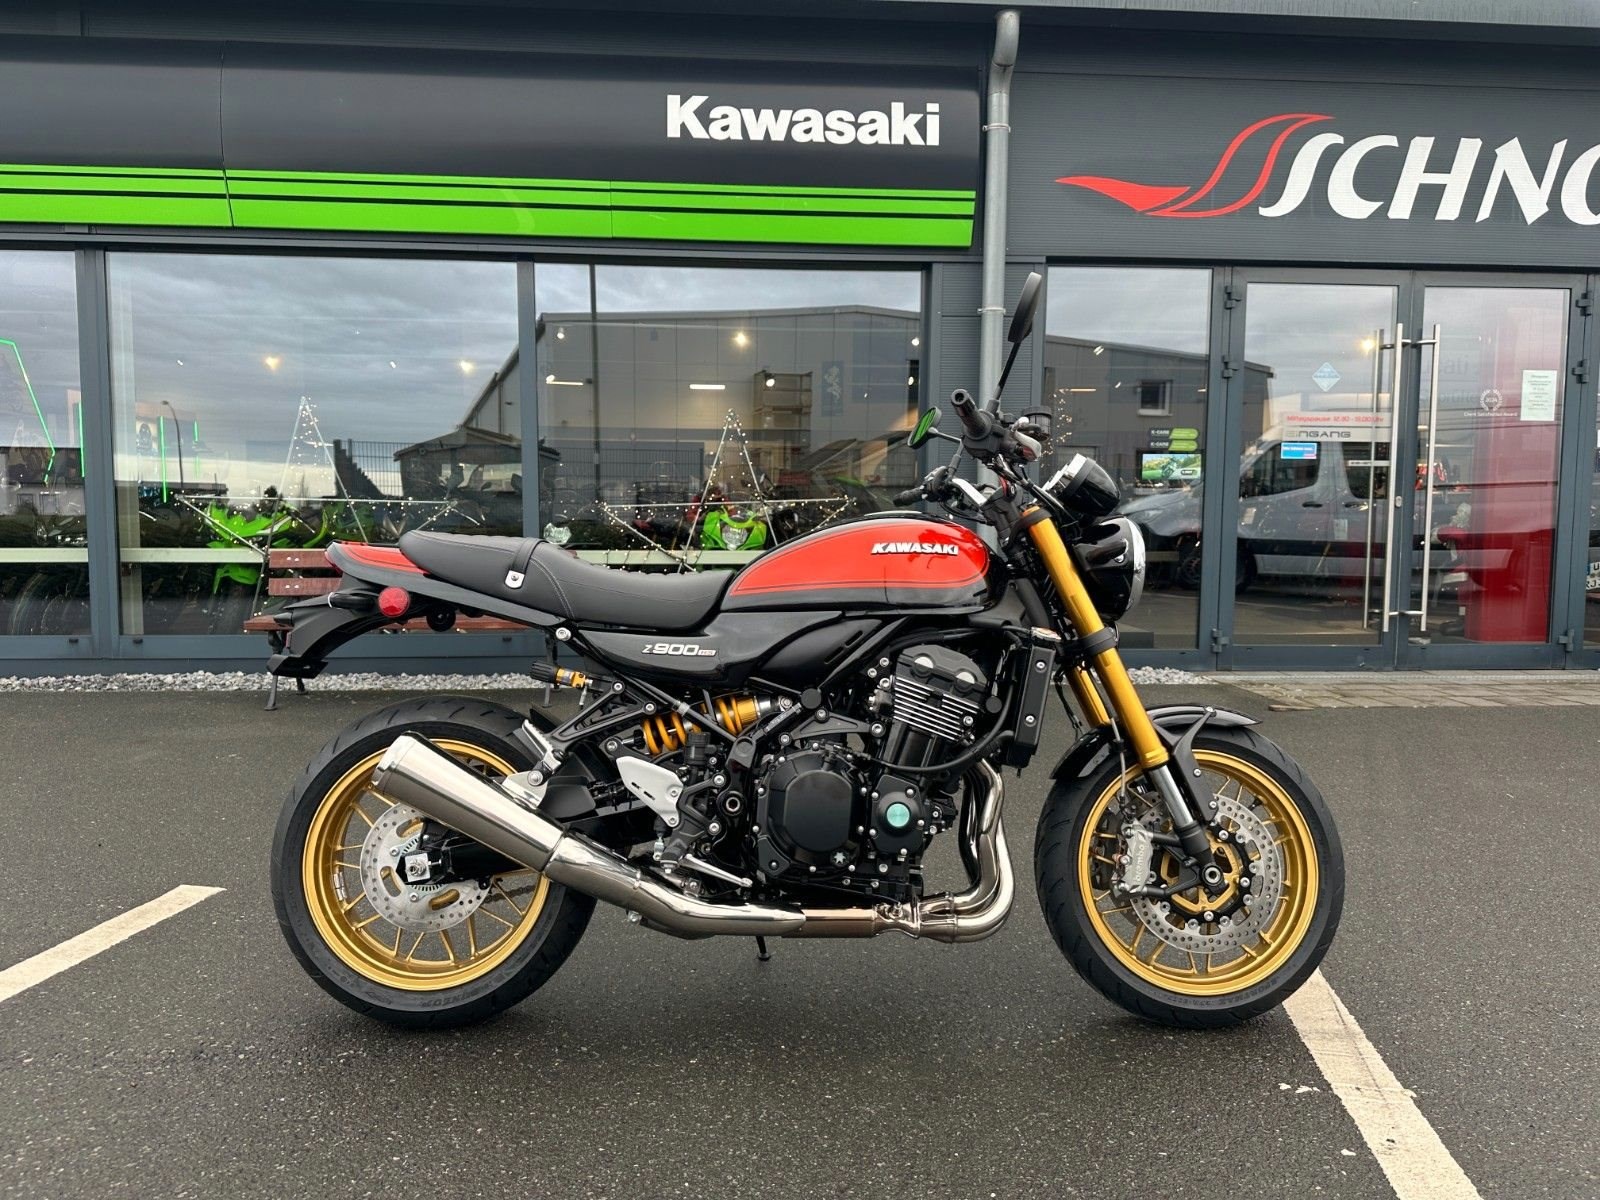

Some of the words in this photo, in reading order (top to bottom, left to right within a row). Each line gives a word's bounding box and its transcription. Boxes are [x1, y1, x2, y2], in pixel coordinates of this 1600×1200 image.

[666, 94, 940, 146] Kawasaki
[870, 542, 959, 556] KAWASAKI
[1136, 844, 1145, 882] brembo
